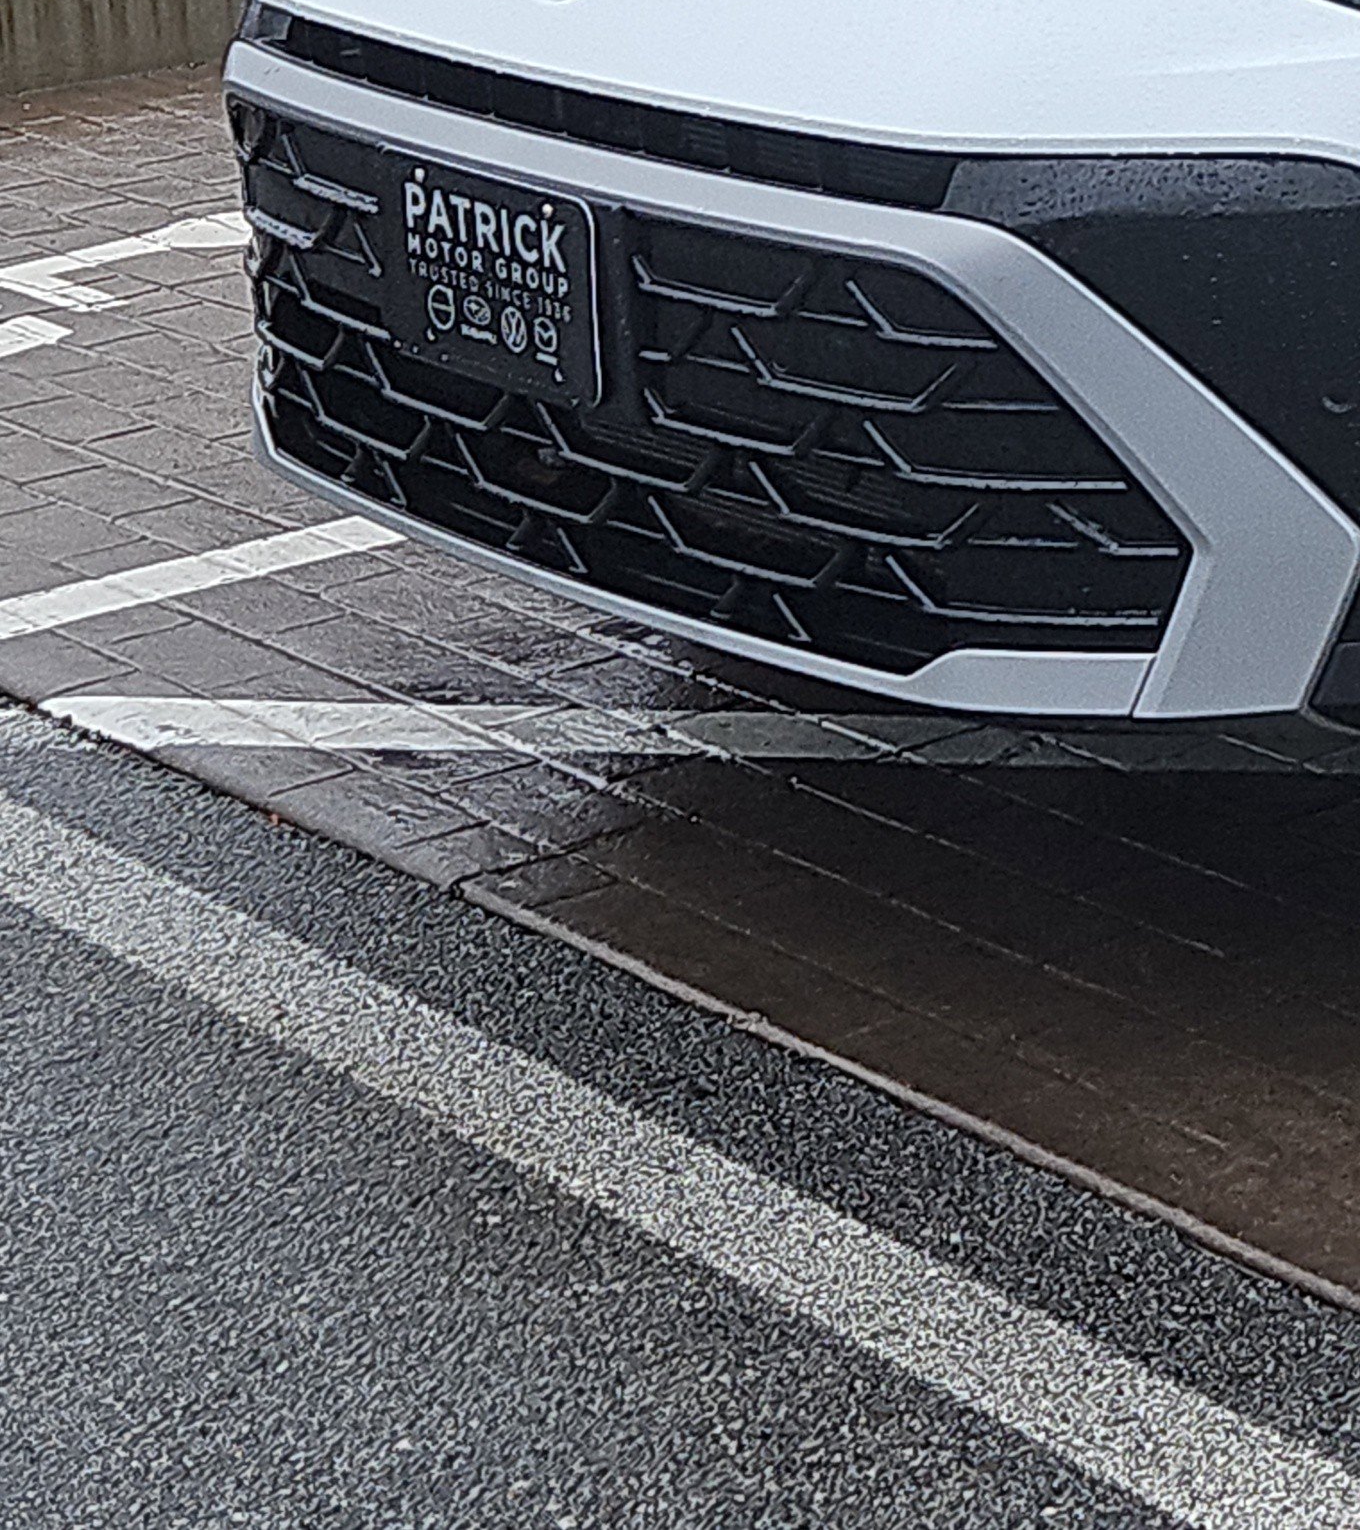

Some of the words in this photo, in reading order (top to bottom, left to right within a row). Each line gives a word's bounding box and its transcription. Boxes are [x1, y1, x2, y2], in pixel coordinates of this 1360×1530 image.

[405, 182, 566, 273] PATRICK
[408, 232, 484, 272] MOTOR
[495, 258, 568, 298] GROUP
[409, 258, 479, 292] TRUSTED
[485, 280, 532, 310] SINCE
